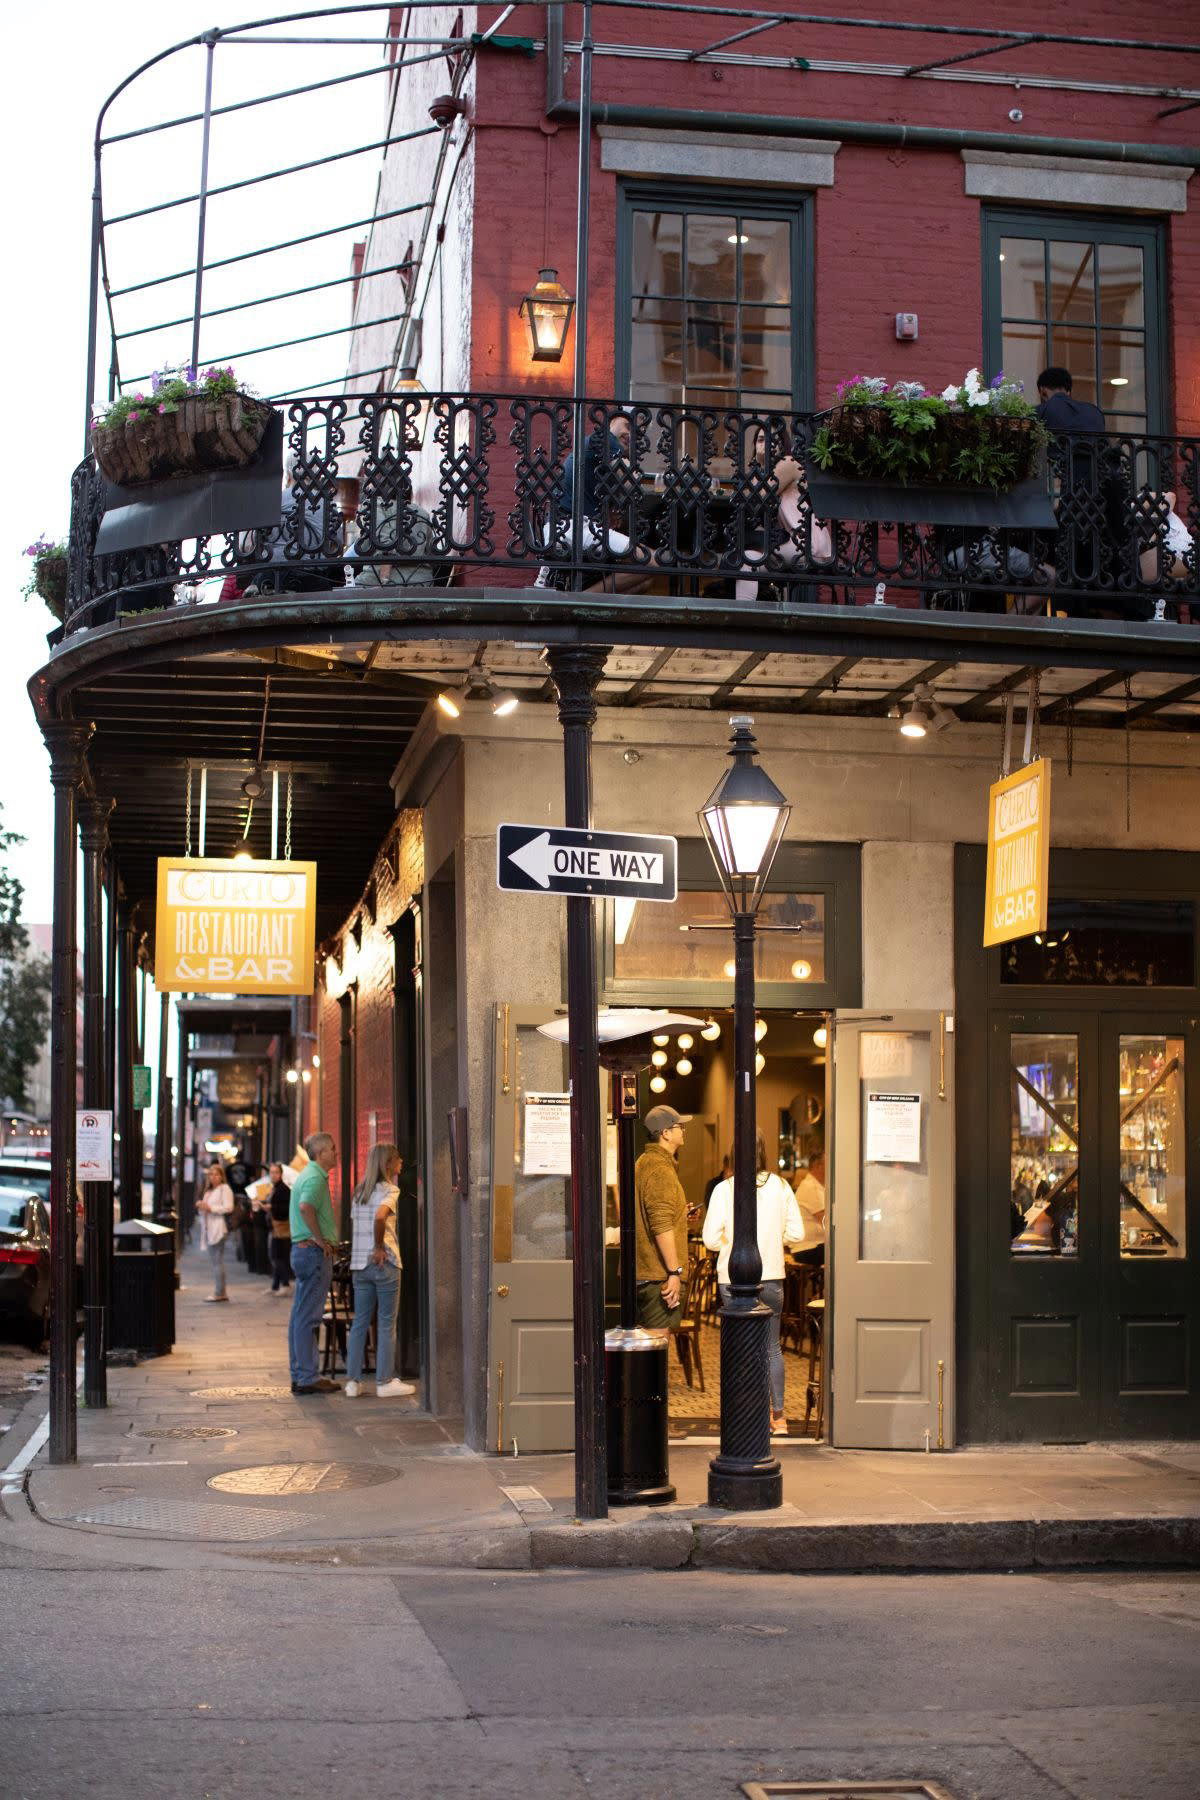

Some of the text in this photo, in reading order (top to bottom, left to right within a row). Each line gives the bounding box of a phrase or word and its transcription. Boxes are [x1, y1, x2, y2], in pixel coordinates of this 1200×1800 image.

[998, 779, 1039, 833] CURIO
[554, 849, 657, 879] ONE WAY
[995, 830, 1039, 897] RESTAURANT
[178, 871, 295, 903] CURIO
[175, 911, 297, 957] RESTAURANT
